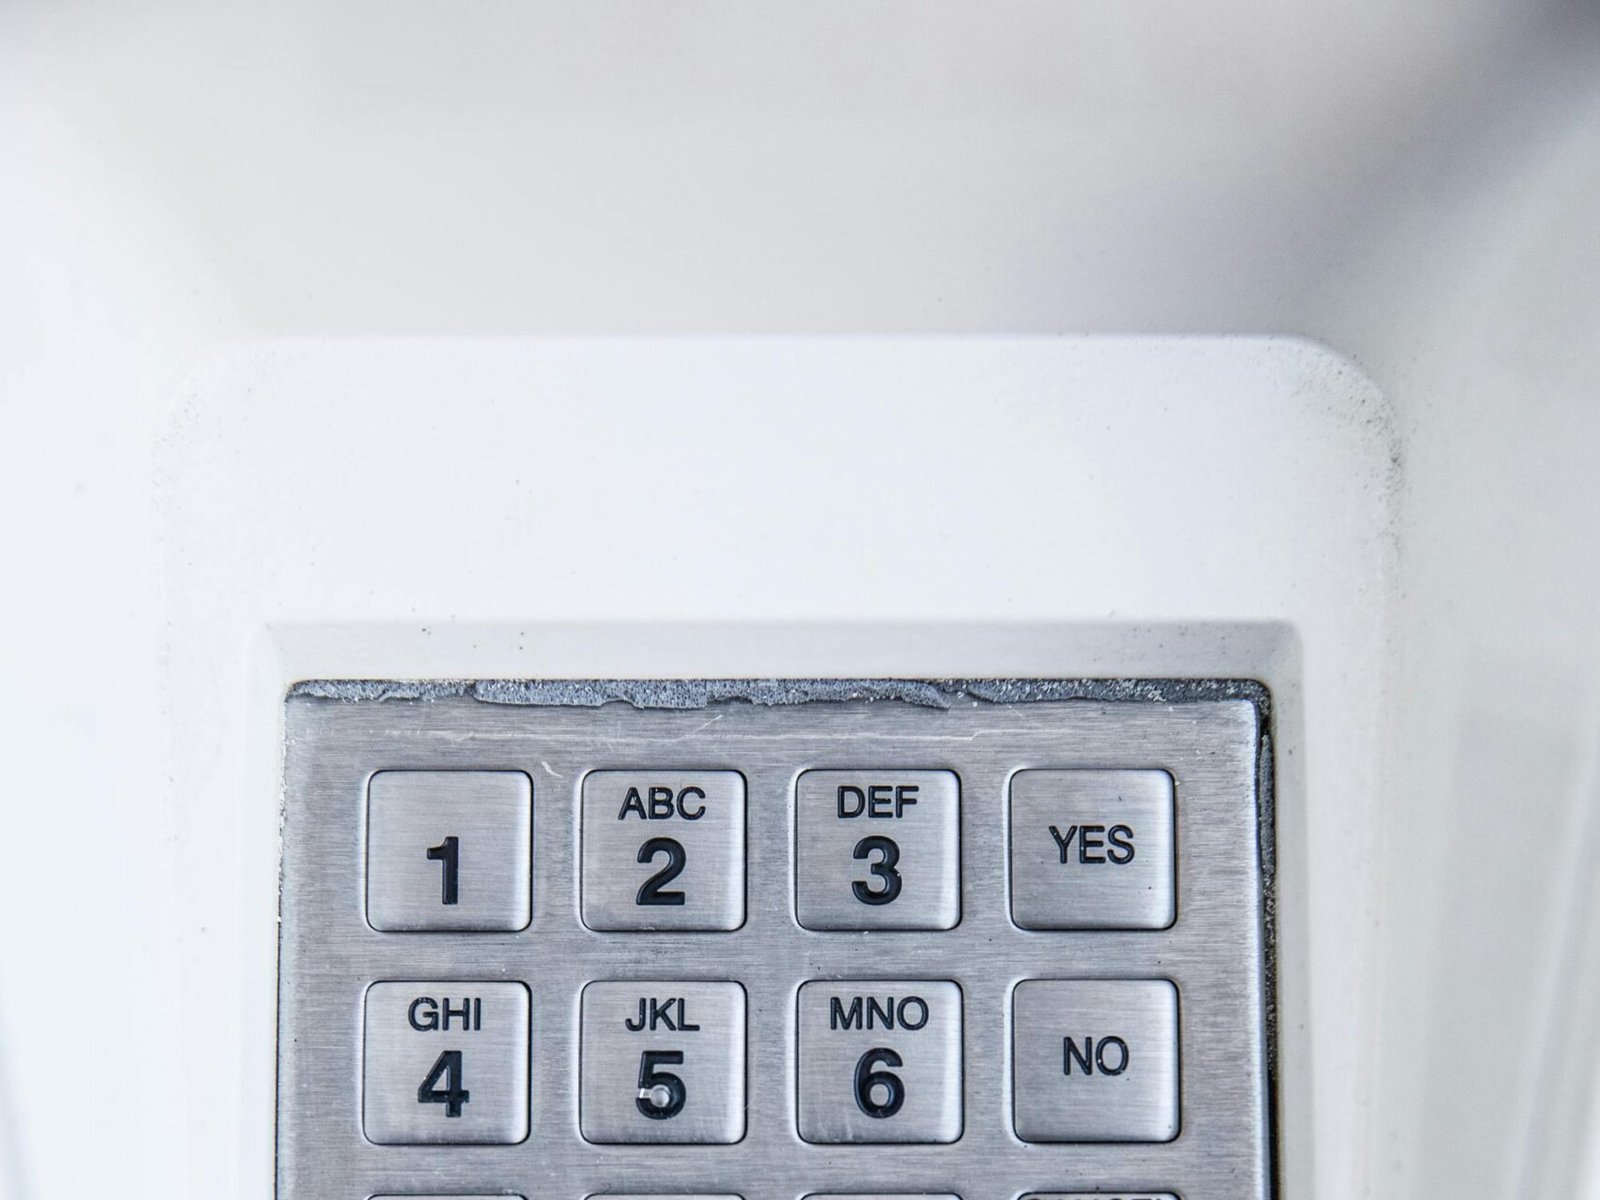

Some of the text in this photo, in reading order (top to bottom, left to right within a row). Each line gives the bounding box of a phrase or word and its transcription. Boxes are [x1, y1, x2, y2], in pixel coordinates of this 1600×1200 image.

[617, 786, 706, 821] ABC
[837, 785, 920, 819] DEF
[1048, 824, 1135, 865] YES
[426, 836, 459, 906] 1
[635, 836, 687, 906] 2
[851, 835, 903, 906] 3
[408, 996, 482, 1032] GHI
[625, 997, 700, 1032] JKL
[830, 995, 929, 1031] MNO
[1063, 1035, 1130, 1077] NO
[417, 1050, 470, 1118] 4
[635, 1050, 687, 1121] 5
[853, 1047, 905, 1119] 6
